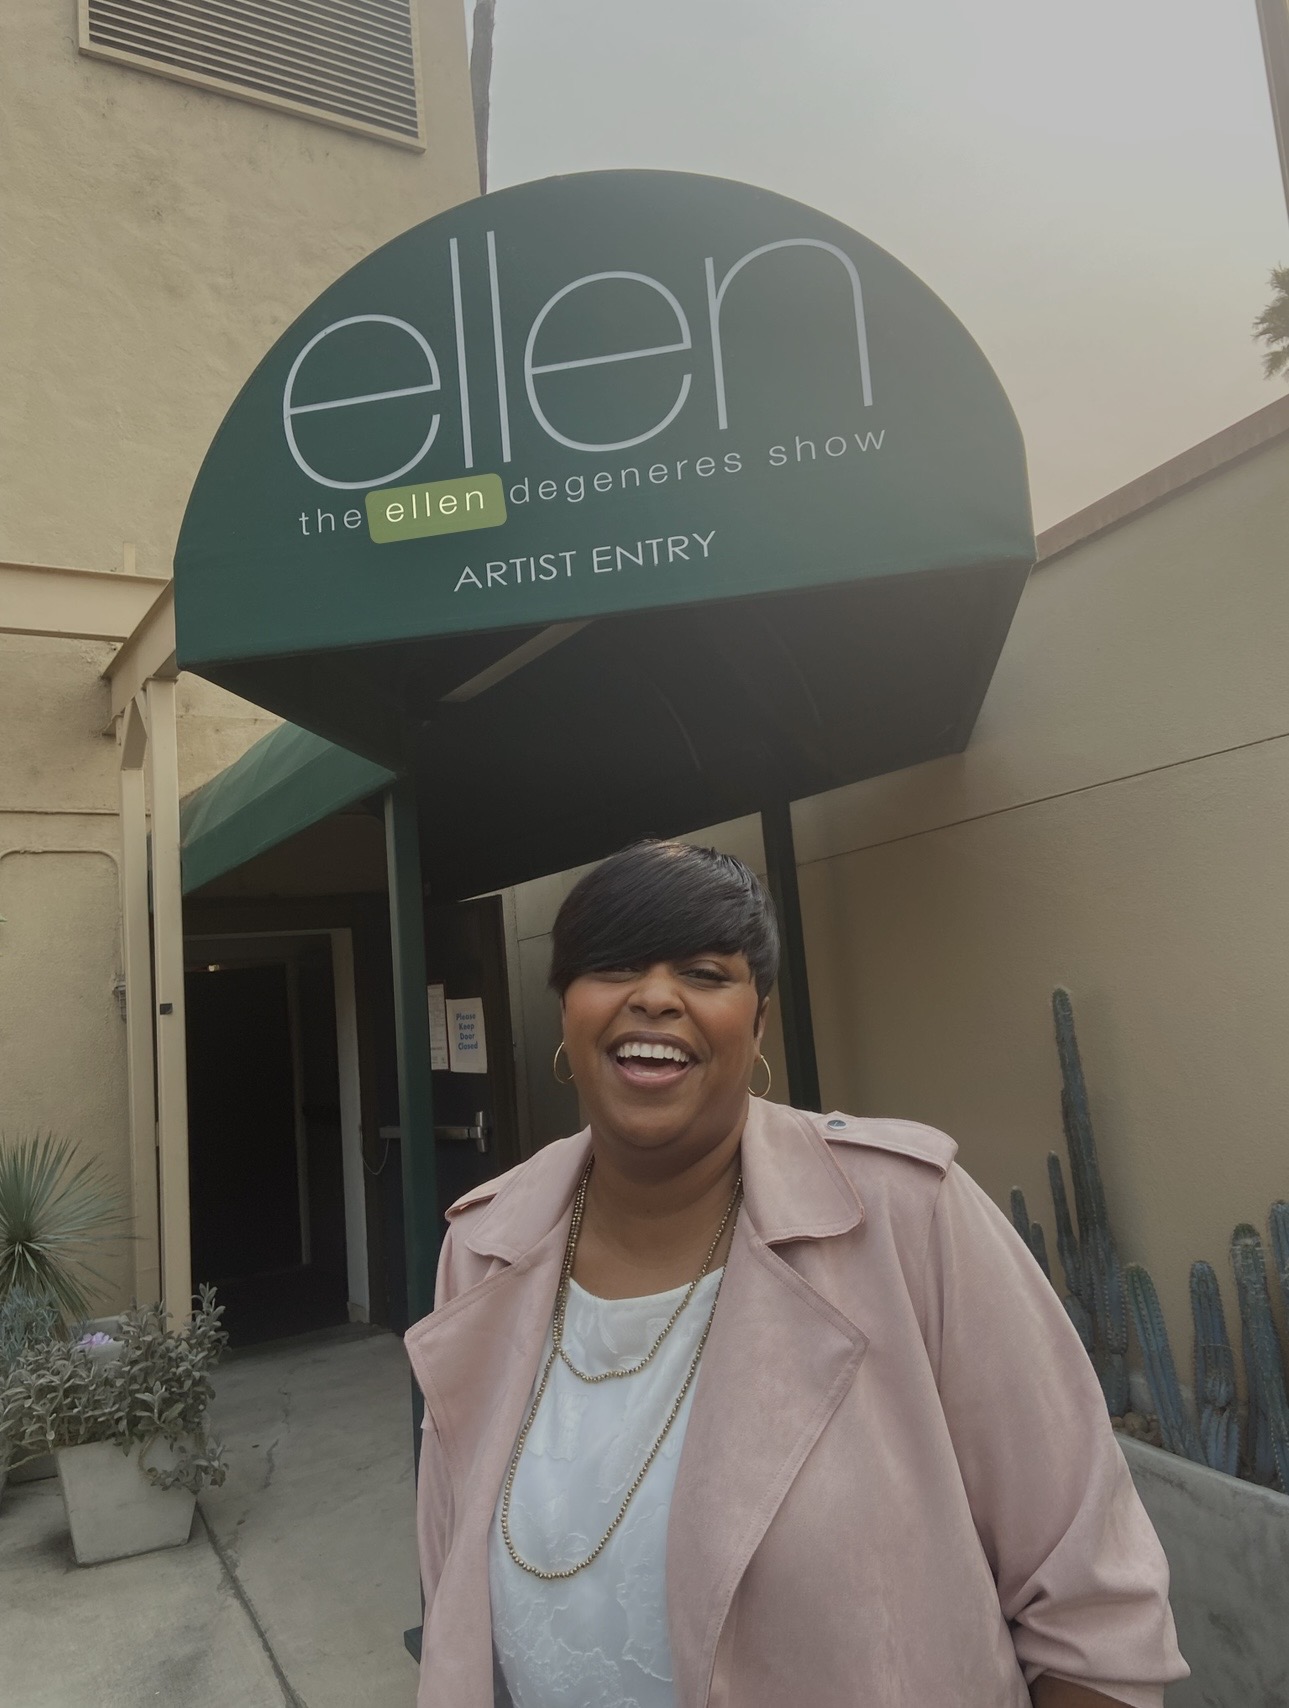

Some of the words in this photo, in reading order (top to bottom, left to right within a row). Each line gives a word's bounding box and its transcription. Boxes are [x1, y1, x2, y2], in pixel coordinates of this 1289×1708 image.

[283, 230, 874, 490] ellen
[299, 507, 363, 536] the
[384, 485, 486, 524] ellen
[509, 451, 743, 503] degeneres
[768, 429, 887, 467] show
[453, 551, 577, 593] ARTIST
[592, 530, 717, 574] ENTRY
[456, 1013, 476, 1021] Please
[459, 1023, 475, 1031] Keep
[458, 1042, 478, 1050] Closed
